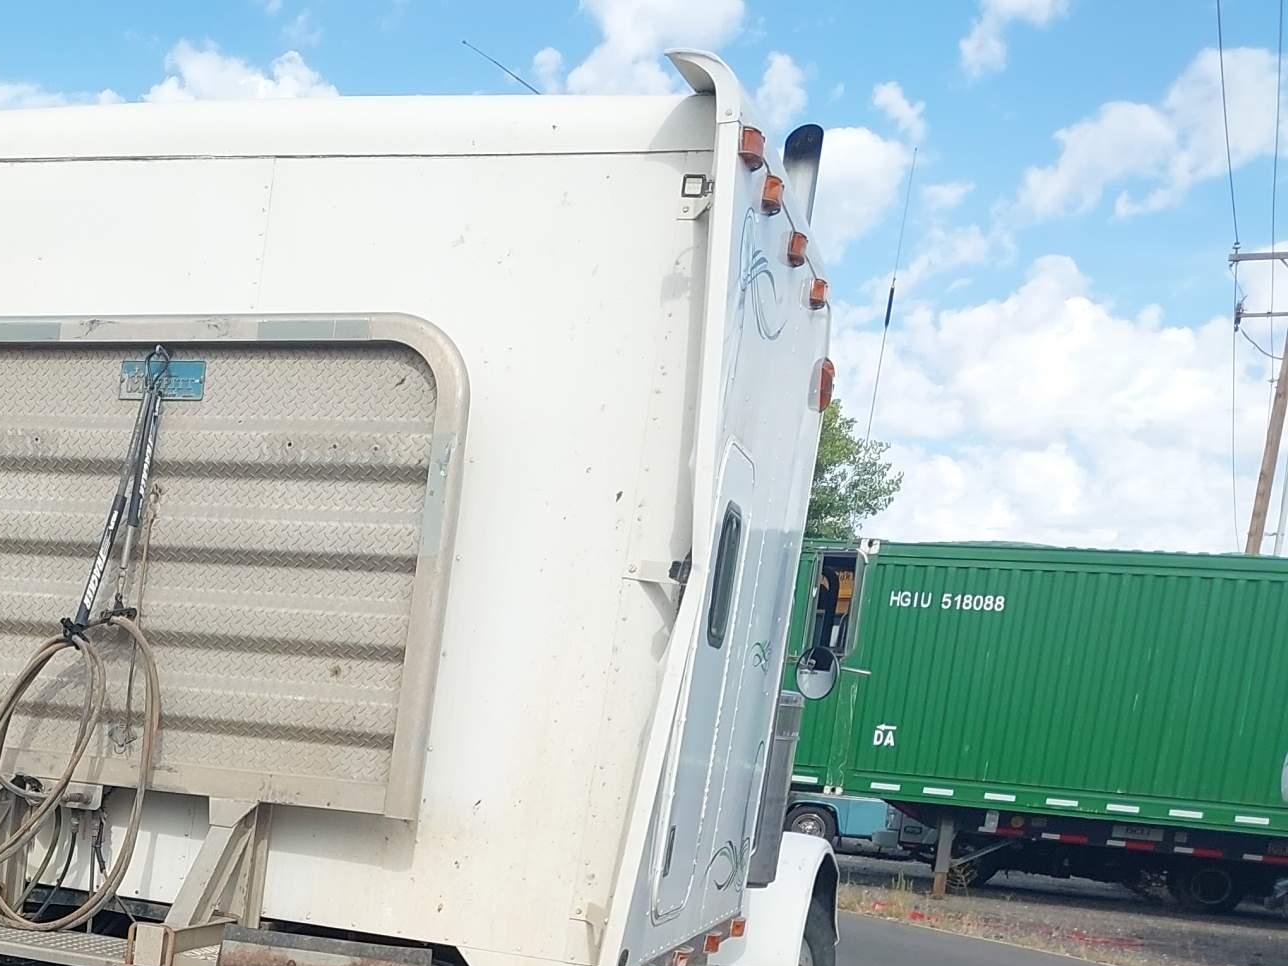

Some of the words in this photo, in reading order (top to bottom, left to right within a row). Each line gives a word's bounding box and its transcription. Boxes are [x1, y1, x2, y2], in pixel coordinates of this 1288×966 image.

[890, 591, 932, 608] HGIU
[941, 593, 1005, 611] 518088
[873, 730, 895, 746] DA
